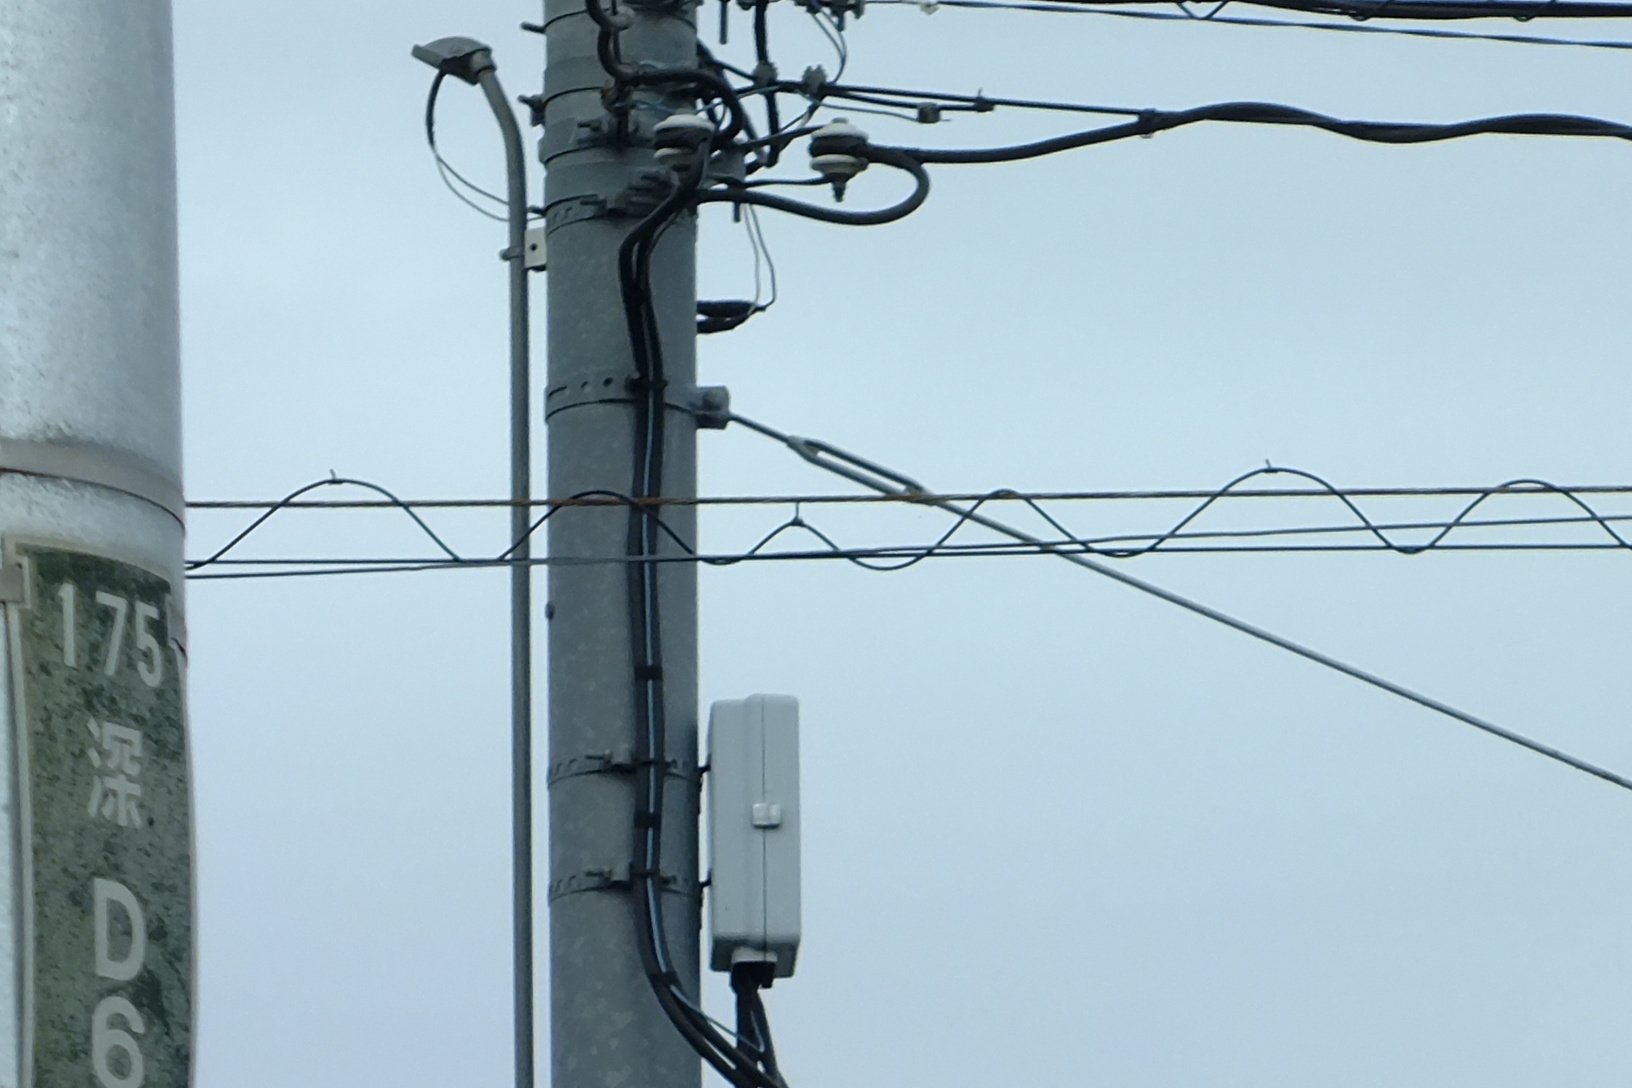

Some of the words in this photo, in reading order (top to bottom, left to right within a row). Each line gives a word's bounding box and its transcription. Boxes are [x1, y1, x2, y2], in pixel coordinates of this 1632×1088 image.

[59, 582, 163, 688] 175
[88, 711, 142, 828] 深
[94, 878, 146, 981] D
